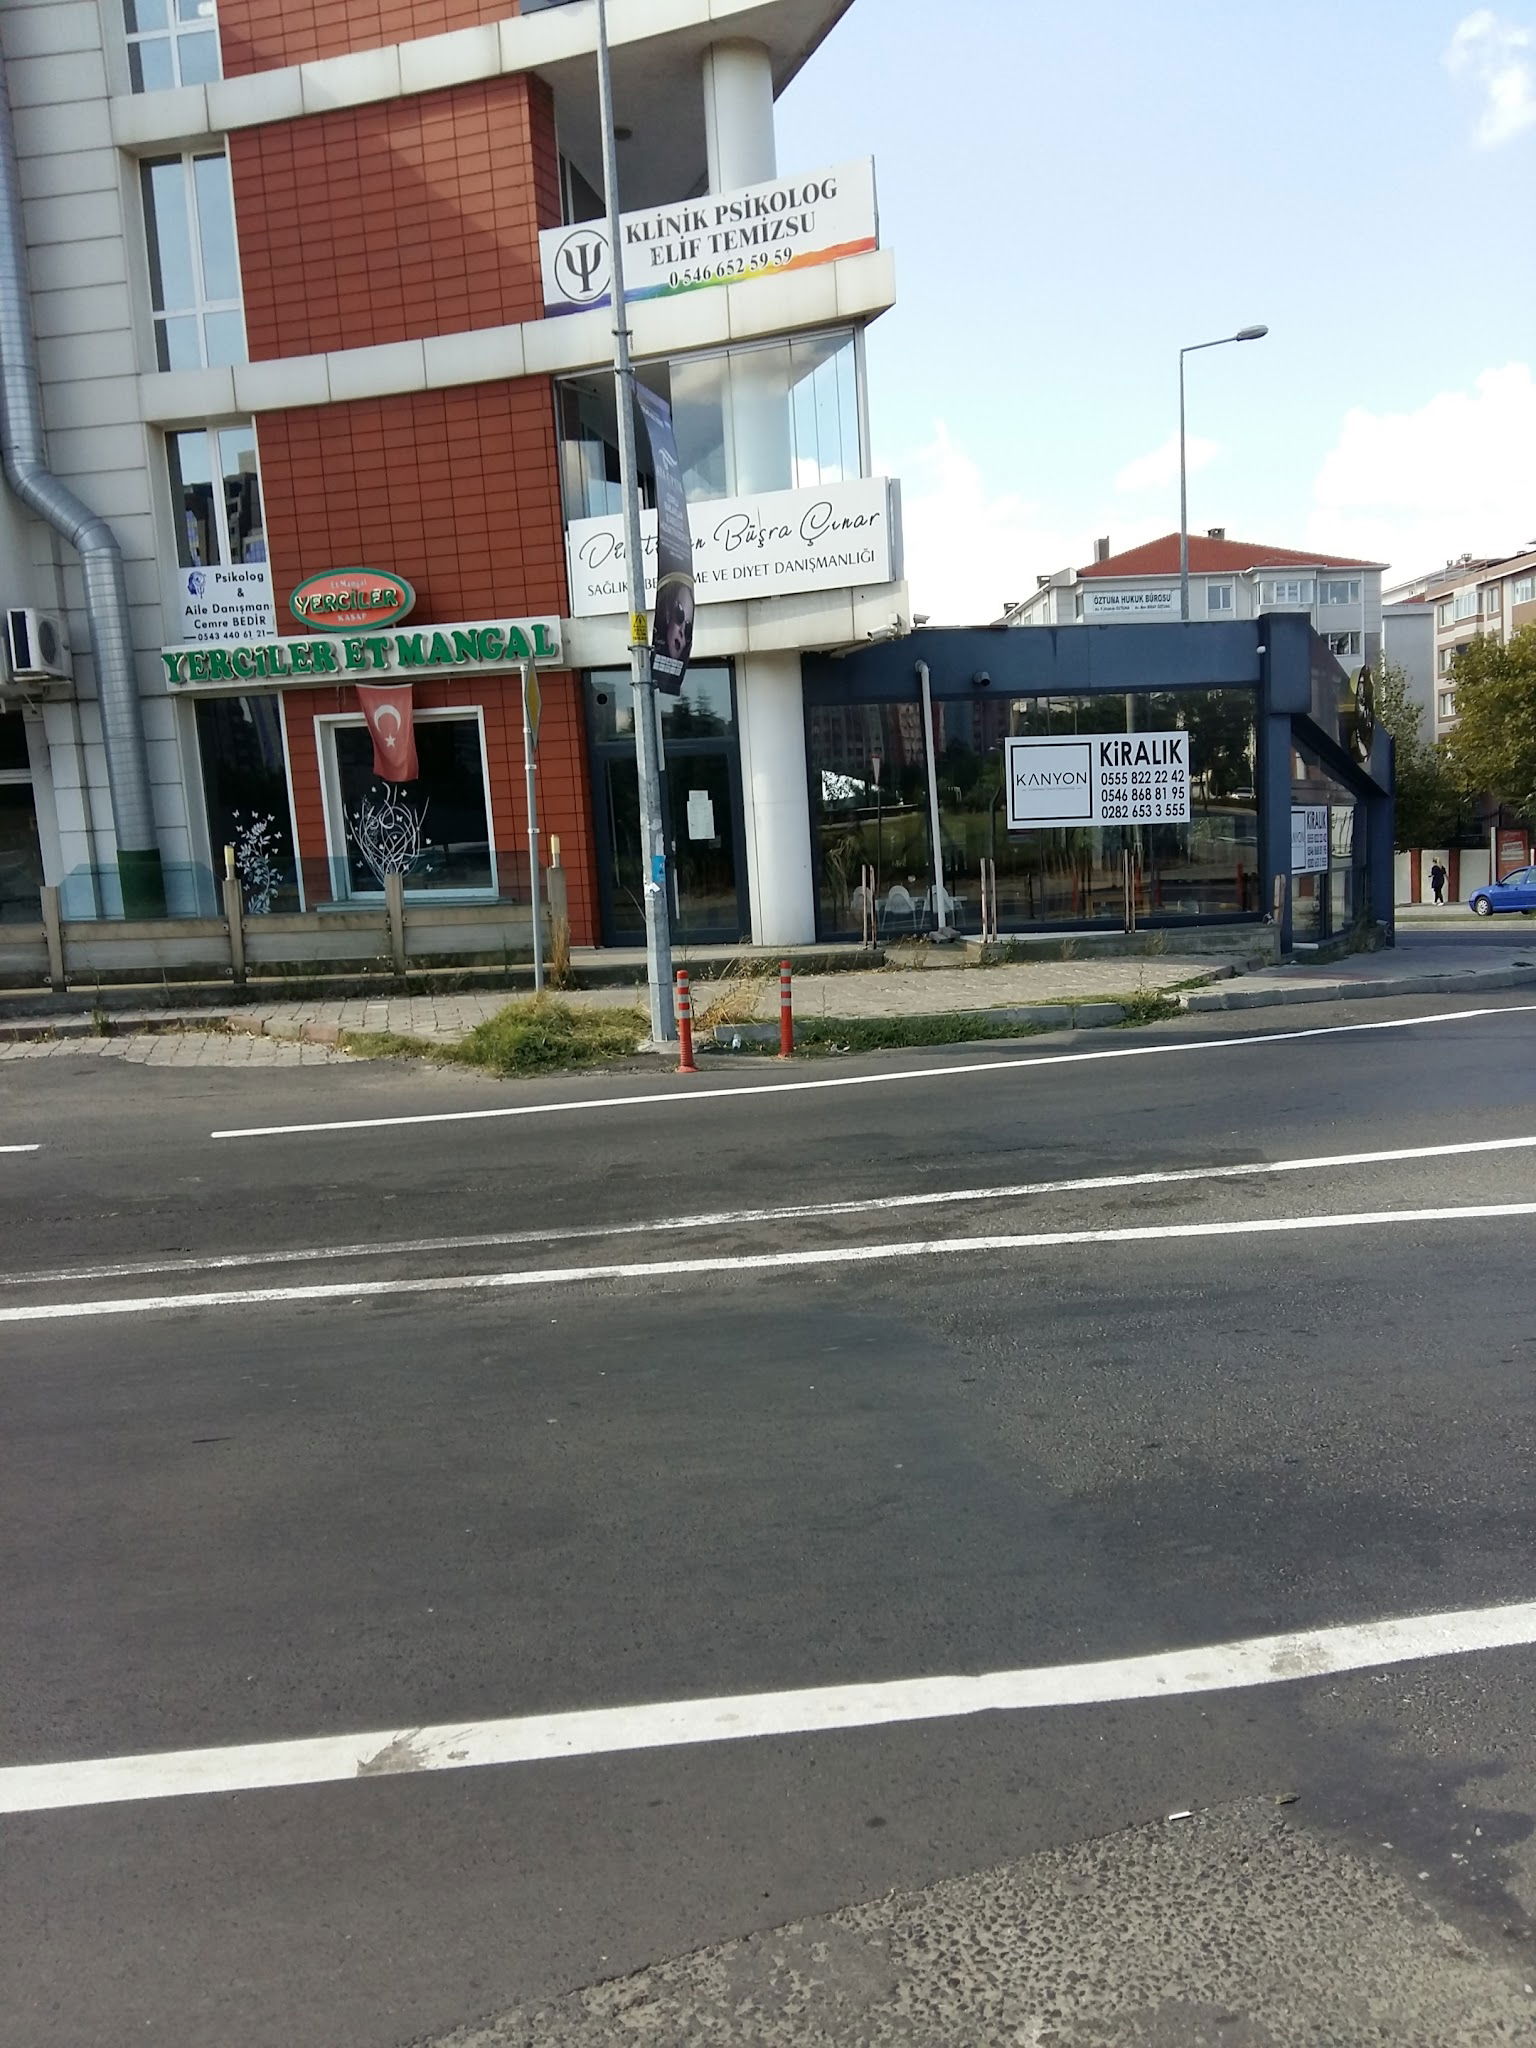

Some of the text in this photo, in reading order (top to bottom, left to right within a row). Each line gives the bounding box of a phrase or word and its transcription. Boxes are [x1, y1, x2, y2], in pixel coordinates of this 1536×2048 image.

[626, 177, 837, 244] KLİNİK PSİKOLOG
[650, 211, 816, 266] ELİF TEMİZSU
[669, 247, 793, 287] 0 546 652 59 59
[713, 513, 793, 552] Büşra
[799, 501, 880, 547] Çınar
[712, 568, 728, 582] VE
[733, 560, 770, 579] DİYET
[775, 548, 875, 574] DANIŞMANLIĞI
[215, 570, 264, 583] Psikolog
[237, 587, 245, 598] &
[1093, 593, 1171, 605] ÖZTUNA HUKUK BÜROSU
[185, 603, 270, 616] Aile Danışman
[194, 614, 267, 629] Cemre BEDİR
[198, 630, 266, 641] 0543 440 61 21
[344, 635, 390, 671] ET
[396, 623, 558, 667] MANGAL
[1016, 772, 1087, 787] KANYON
[1101, 769, 1185, 786] 0555 822 22 42
[1101, 786, 1185, 802] 0546 868 81 95
[1101, 803, 1185, 819] 0282 653 3 555
